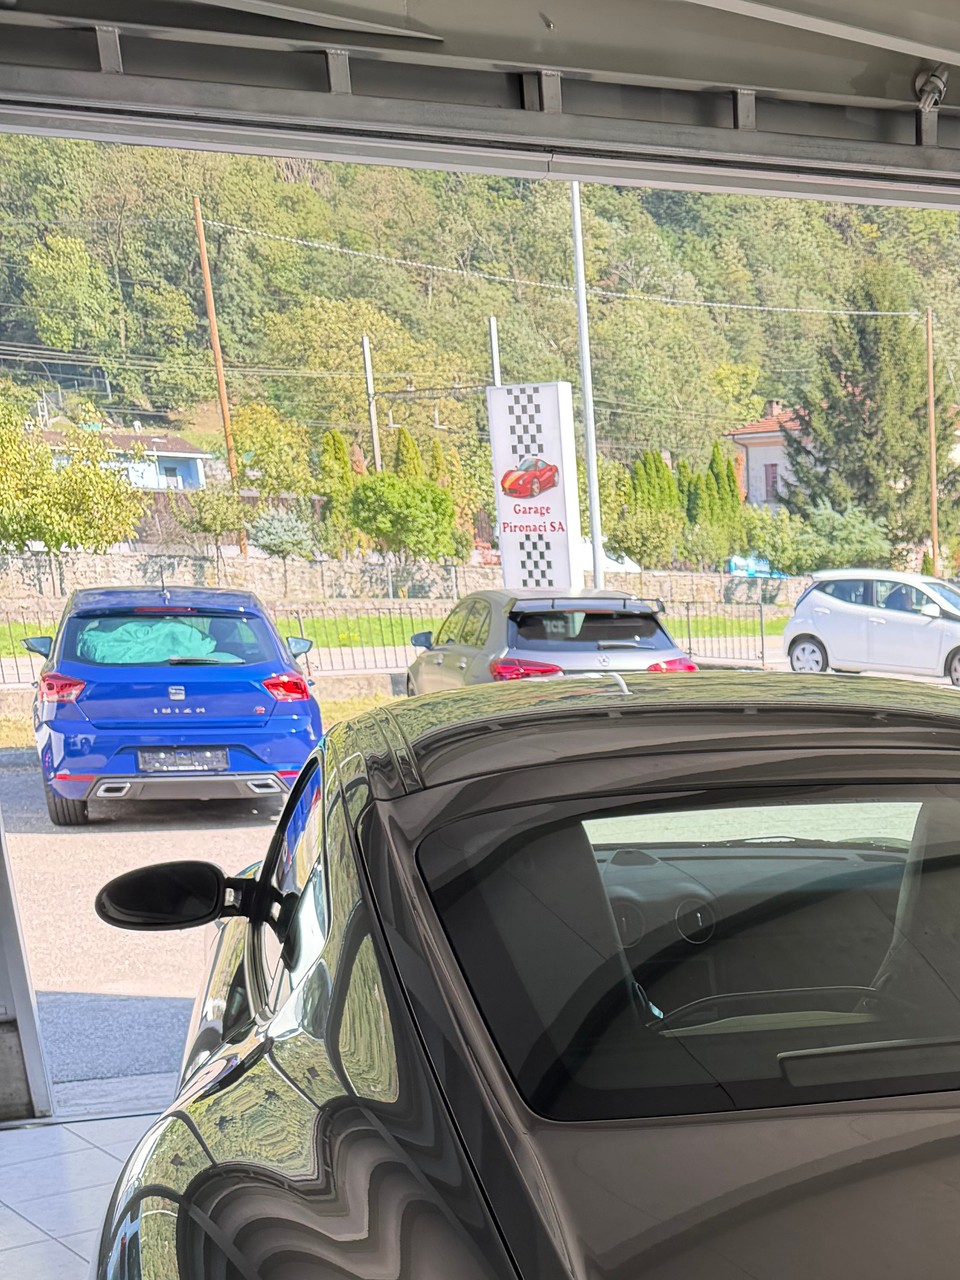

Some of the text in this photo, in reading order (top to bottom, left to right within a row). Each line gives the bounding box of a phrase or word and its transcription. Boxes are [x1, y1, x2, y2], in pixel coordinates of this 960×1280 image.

[513, 503, 551, 517] Garage
[502, 520, 566, 533] Pironaci SA
